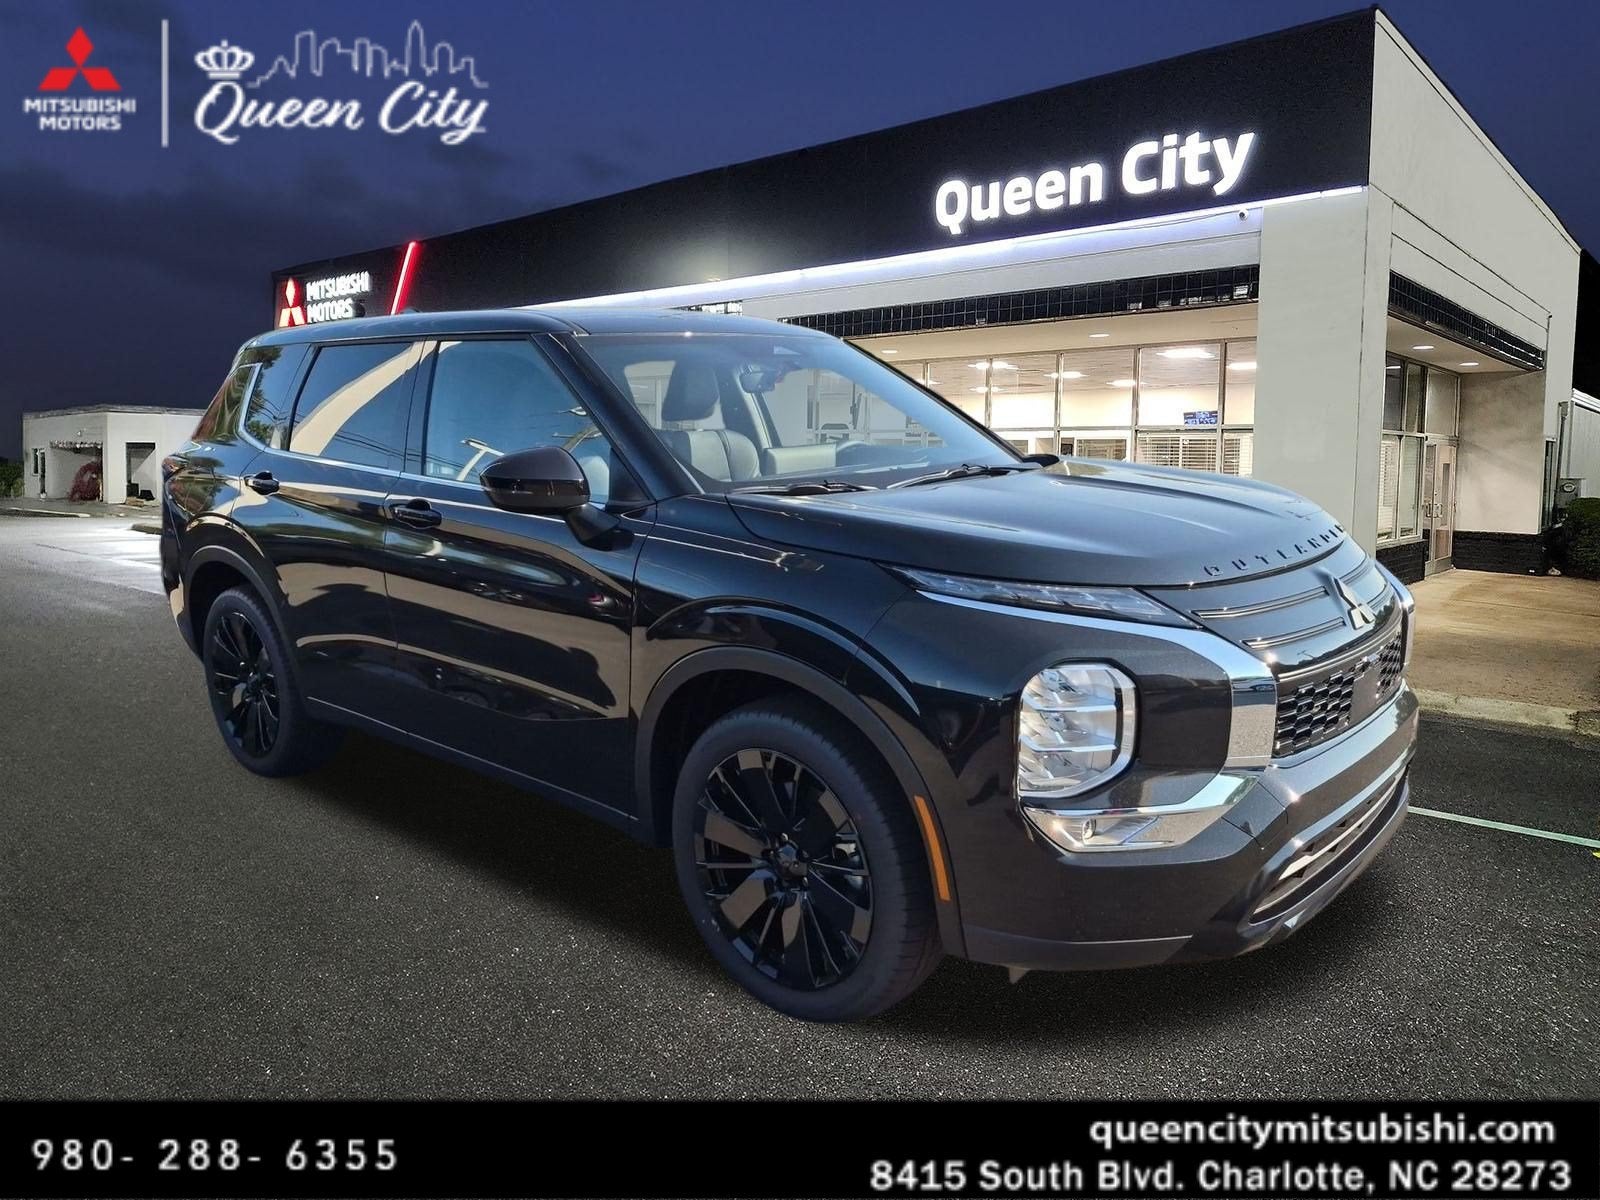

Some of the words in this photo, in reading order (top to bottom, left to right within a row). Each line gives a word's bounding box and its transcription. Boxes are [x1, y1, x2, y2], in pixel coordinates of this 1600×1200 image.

[935, 161, 1104, 235] Queen
[1121, 131, 1257, 197] City
[305, 271, 371, 301] MITSUBISHI
[306, 298, 355, 323] MOTORS
